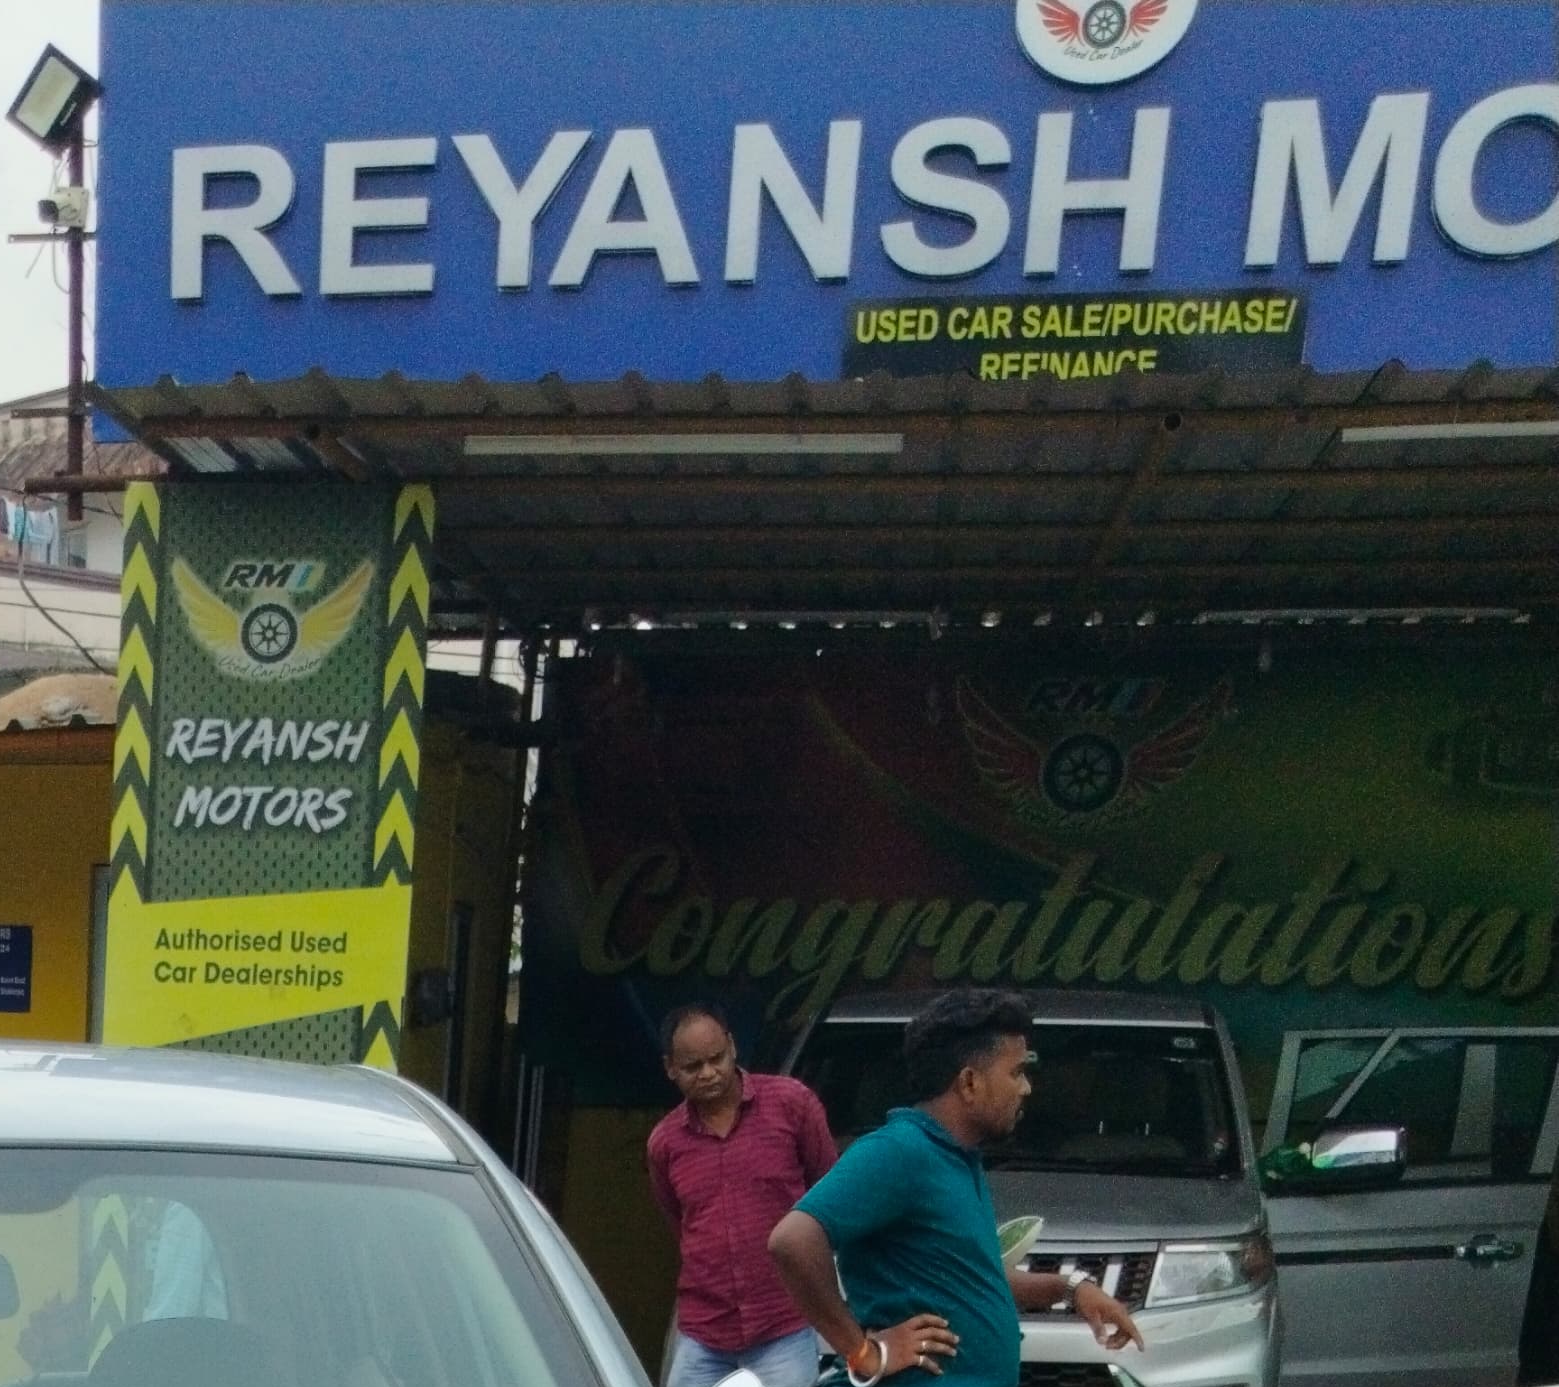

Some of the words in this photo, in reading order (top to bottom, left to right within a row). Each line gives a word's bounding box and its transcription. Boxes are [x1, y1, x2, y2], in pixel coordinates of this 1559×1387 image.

[1088, 50, 1107, 61] Car
[169, 107, 1172, 300] REYANSH
[856, 308, 938, 343] USED
[947, 305, 1012, 340] CAR
[1021, 297, 1298, 339] SALE/PURCHASE/
[217, 655, 249, 675] Used
[250, 663, 274, 678] Car
[280, 657, 322, 679] Dealer
[165, 717, 370, 765] REYANSH
[173, 785, 353, 833] MOTORS
[155, 928, 282, 952] Authorised
[290, 930, 348, 953] Used
[578, 848, 1552, 1030] Congratulations
[154, 961, 197, 983] Car
[204, 961, 344, 991] Dealerships
